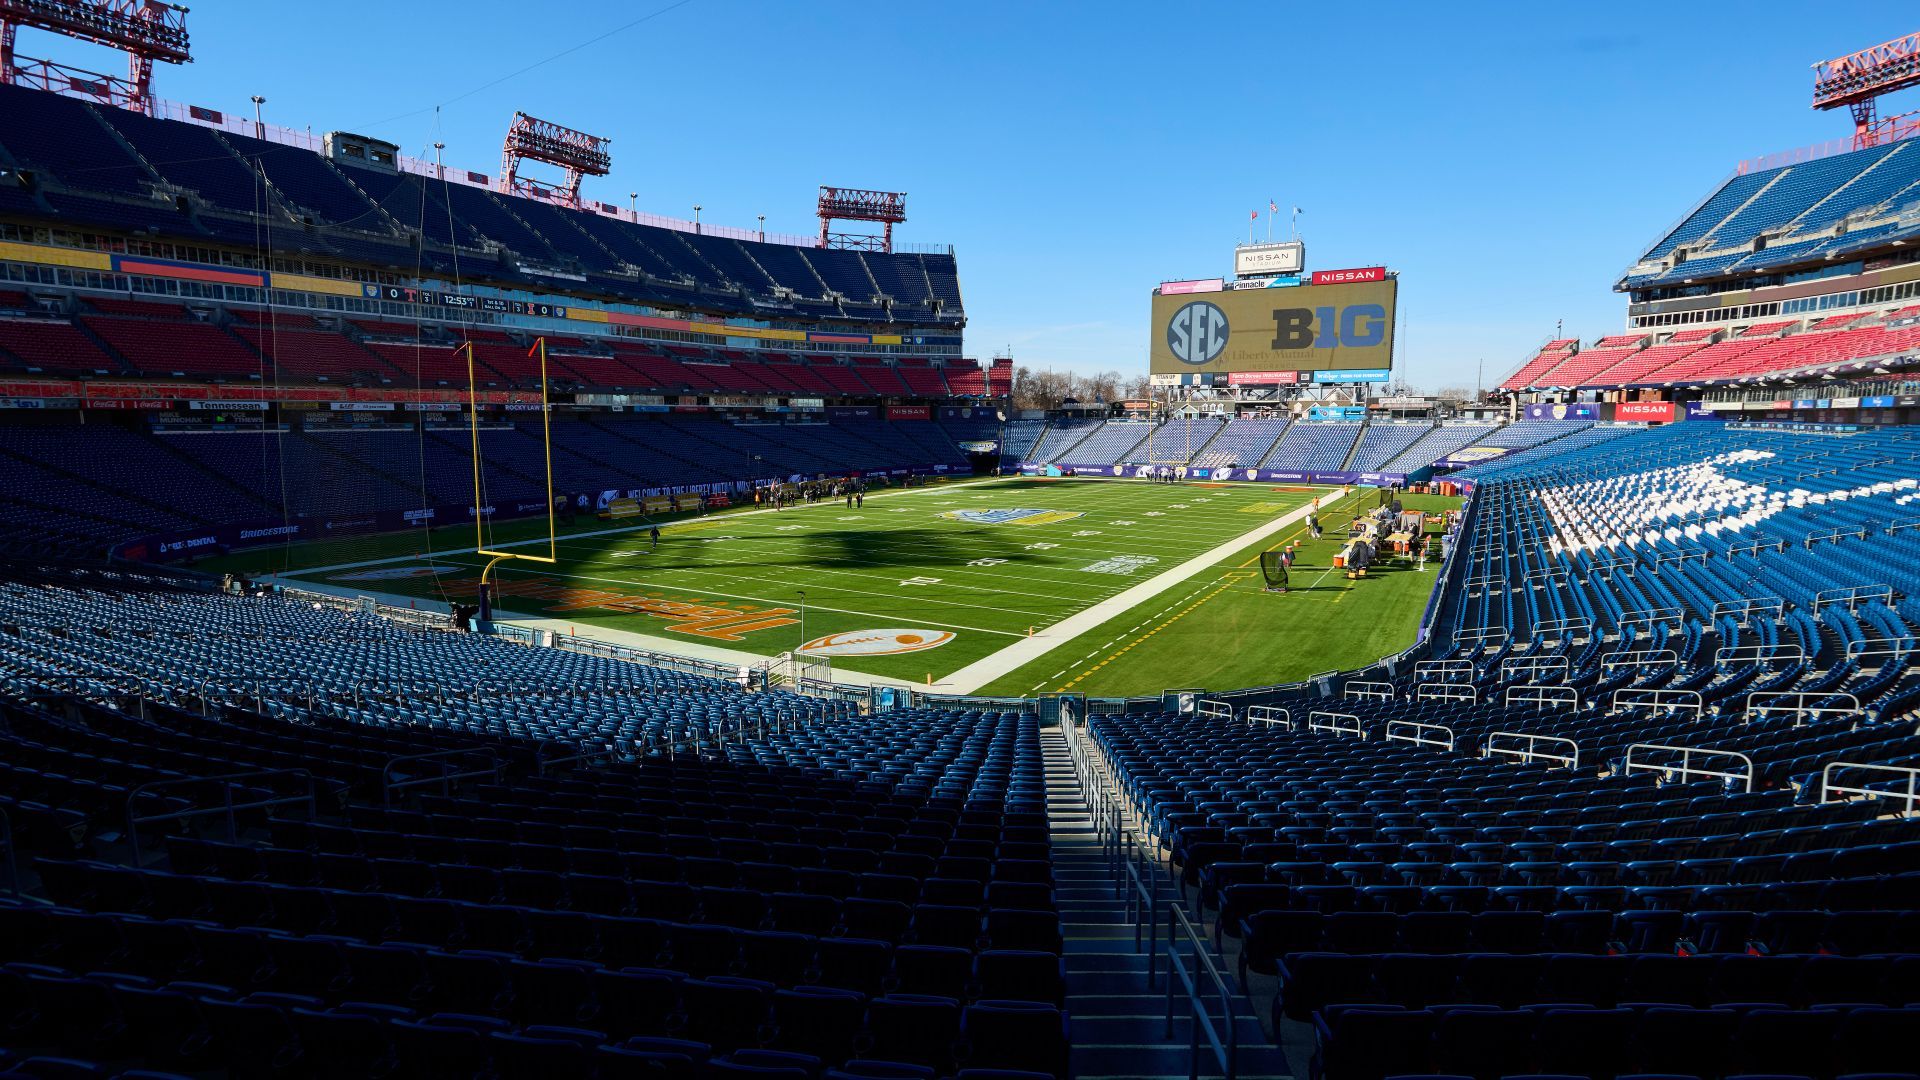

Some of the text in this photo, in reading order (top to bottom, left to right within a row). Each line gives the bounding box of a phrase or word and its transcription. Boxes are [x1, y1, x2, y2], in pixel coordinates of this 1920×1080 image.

[1245, 253, 1289, 262] NISSAN
[1321, 270, 1376, 282] NISSAN
[1234, 280, 1265, 290] Pinnacle
[390, 288, 398, 298] 0
[444, 295, 467, 306] 12:53
[541, 306, 548, 314] 0
[1171, 303, 1226, 362] SEC
[1233, 349, 1315, 361] Liberty Mutual
[1622, 406, 1667, 414] NISSAN
[627, 488, 660, 498] WELCOME
[663, 487, 672, 496] TO
[672, 486, 684, 495] THE
[686, 483, 711, 495] LIBERTY
[239, 525, 300, 539] BRIDGESTONE
[187, 536, 217, 547] DENTAL
